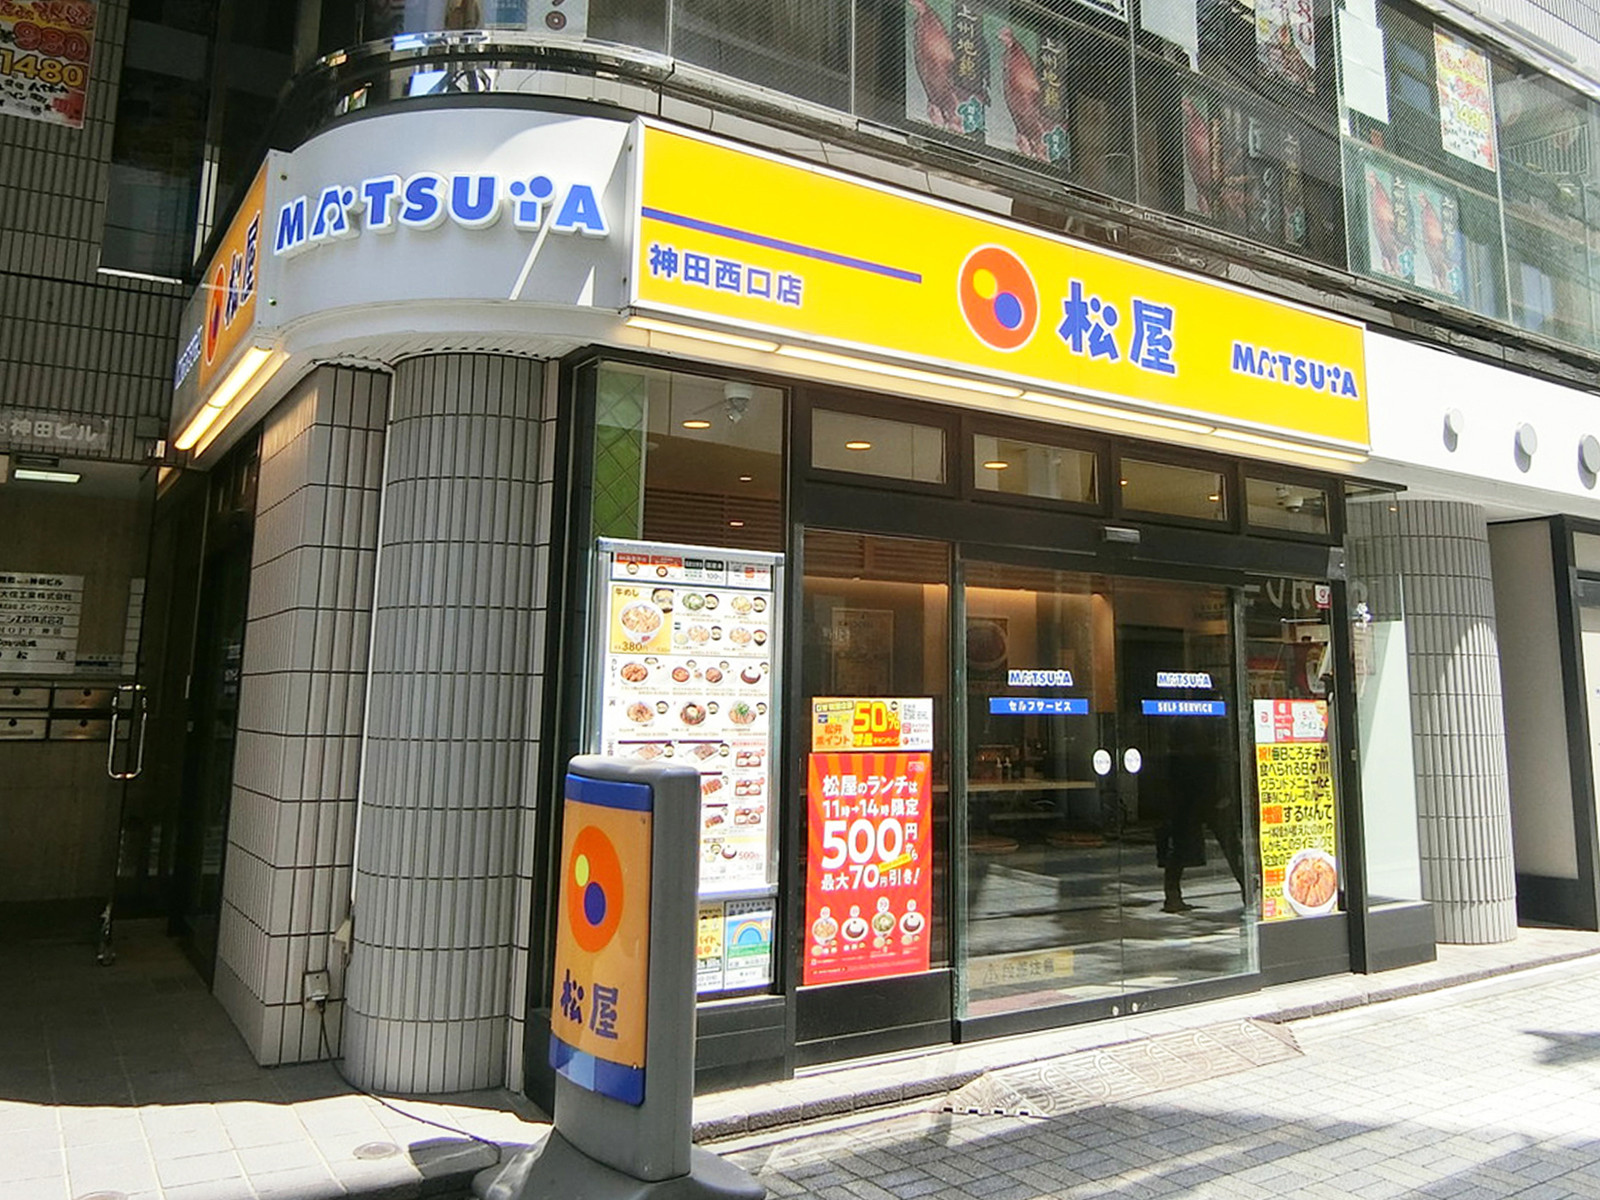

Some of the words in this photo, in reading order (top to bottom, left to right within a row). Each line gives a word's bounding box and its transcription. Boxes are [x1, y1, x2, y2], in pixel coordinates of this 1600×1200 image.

[13, 21, 88, 61] 980
[276, 175, 605, 253] MATSUYA
[649, 244, 802, 306] 神田西口店
[1058, 281, 1176, 375] 松屋
[1232, 343, 1358, 398] MATSUYA
[615, 587, 639, 598] 牛めし
[1008, 670, 1073, 687] MATSUYA
[1157, 672, 1212, 688] MATSUYA
[853, 701, 900, 733] 50%
[1008, 700, 1072, 713] セルフサービス
[1158, 702, 1177, 713] SELF
[1179, 703, 1213, 714] SERVICE
[815, 735, 850, 746] ポイント
[822, 774, 918, 796] 松屋のランチは
[560, 969, 619, 1040] 松屋
